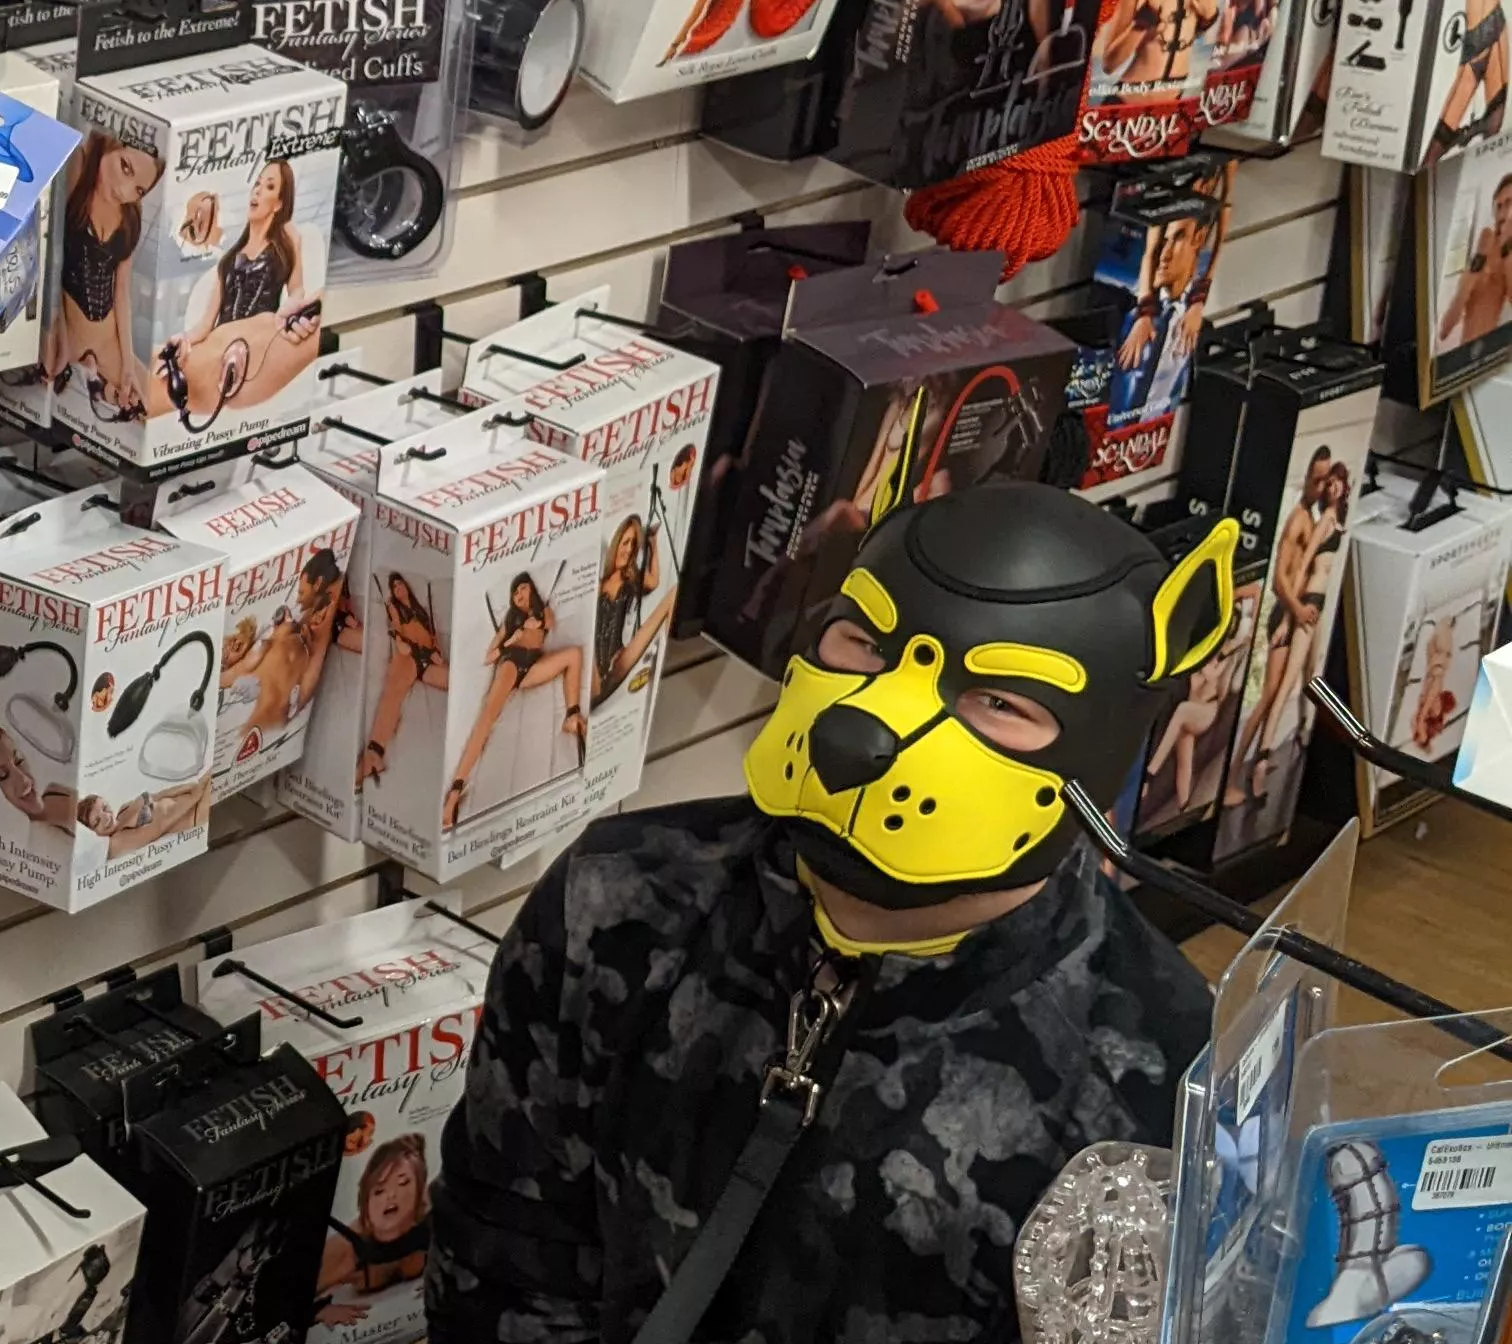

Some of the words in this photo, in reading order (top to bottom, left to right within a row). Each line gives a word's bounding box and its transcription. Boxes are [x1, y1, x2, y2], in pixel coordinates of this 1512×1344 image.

[39, 9, 51, 24] to
[53, 4, 76, 22] the
[93, 29, 136, 53] Fetish
[137, 27, 152, 43] to
[154, 23, 176, 41] the
[178, 10, 240, 38] Extreme!
[268, 27, 361, 60] Fantasy
[364, 52, 424, 81] Cuffs
[80, 94, 160, 147] FETISH
[174, 94, 342, 173] FETISH
[1078, 109, 1180, 158] SCANDAL
[525, 339, 667, 412] FETISH
[152, 437, 203, 459] Vibrating
[205, 427, 237, 448] Pussy
[239, 417, 269, 438] Pump
[580, 374, 712, 461] FETISH
[416, 449, 560, 508] FETISH
[745, 438, 808, 569] Temptasia
[204, 486, 301, 537] FETISH
[376, 504, 450, 552] FETISH
[461, 481, 600, 567] FETISH
[31, 535, 175, 585] FETISH
[471, 532, 545, 573] Fantasy
[95, 562, 225, 644] FETISH
[105, 614, 171, 652] Fantasy
[174, 594, 225, 633] Series
[9, 841, 63, 875] Intensity
[447, 844, 468, 866] Bed
[470, 827, 514, 855] Bindings
[515, 803, 559, 832] Restraint
[76, 866, 102, 892] High
[104, 852, 145, 881] Intensity
[146, 840, 175, 862] Pussy
[396, 960, 462, 995] Series
